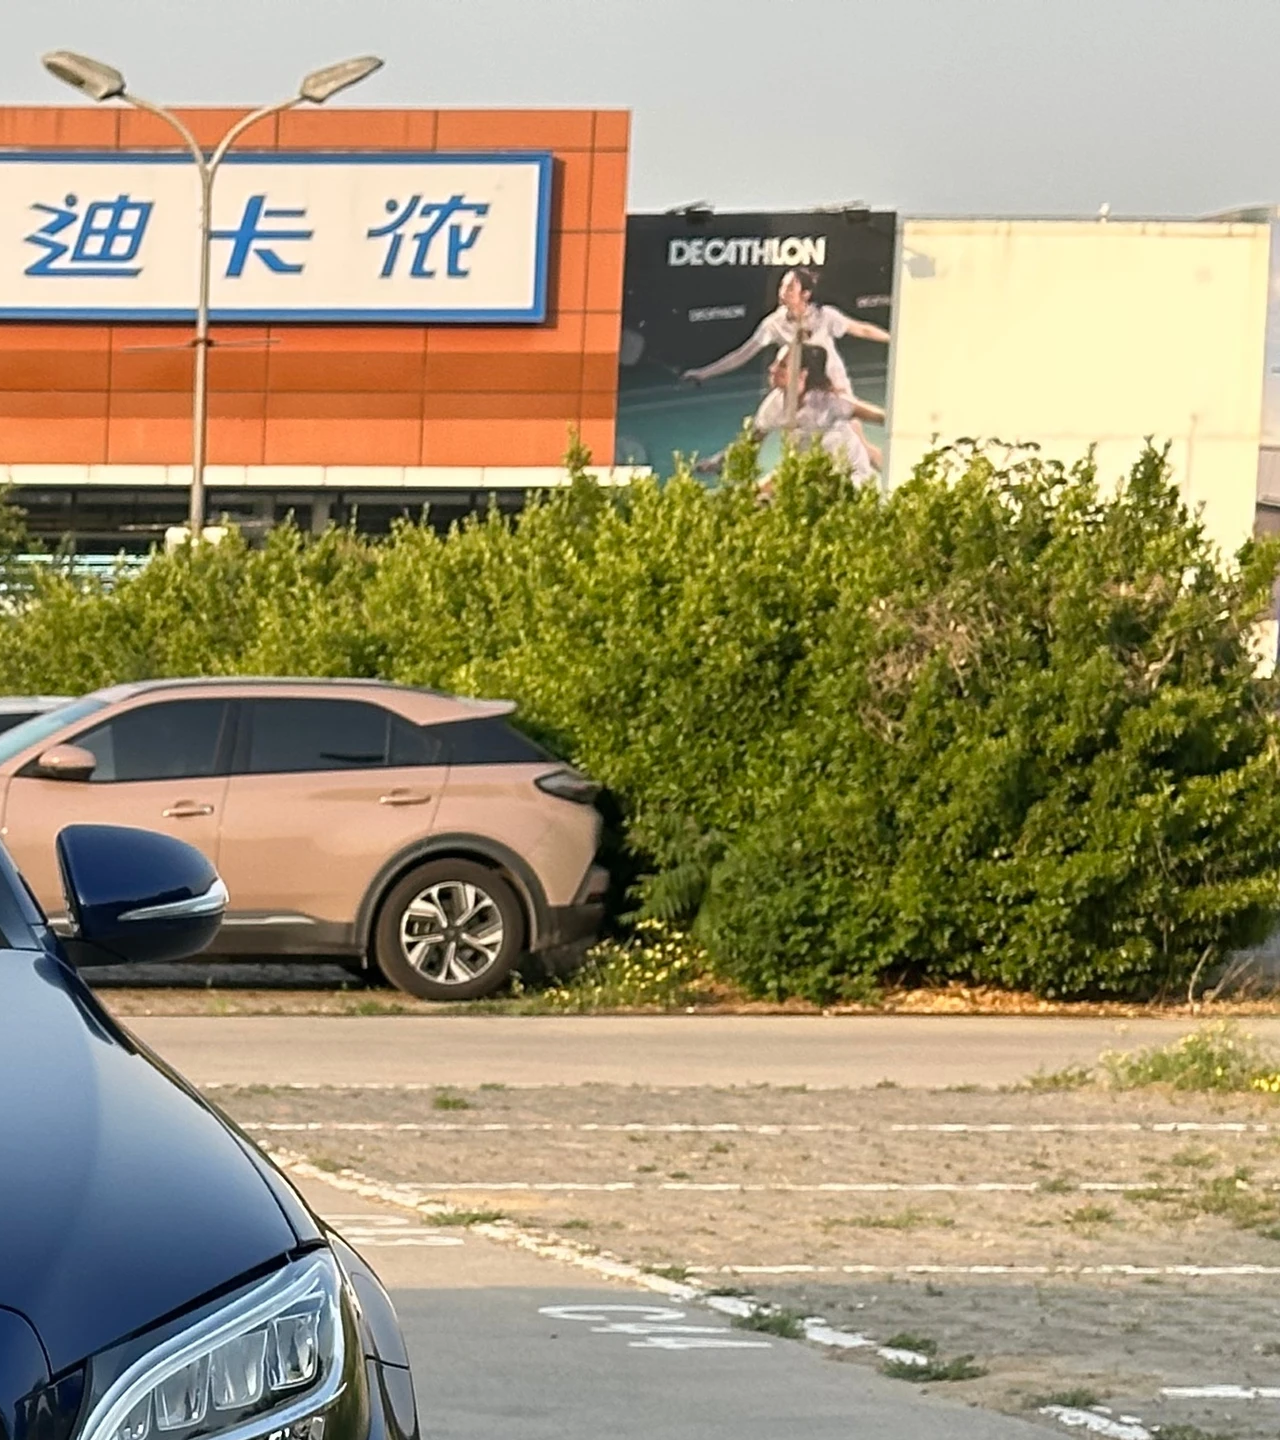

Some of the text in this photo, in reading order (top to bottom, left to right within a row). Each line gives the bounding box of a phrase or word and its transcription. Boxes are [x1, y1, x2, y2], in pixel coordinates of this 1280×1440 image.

[23, 193, 491, 279] 迪卡侬
[668, 236, 827, 266] DECATHLON
[538, 1304, 773, 1349] C44
